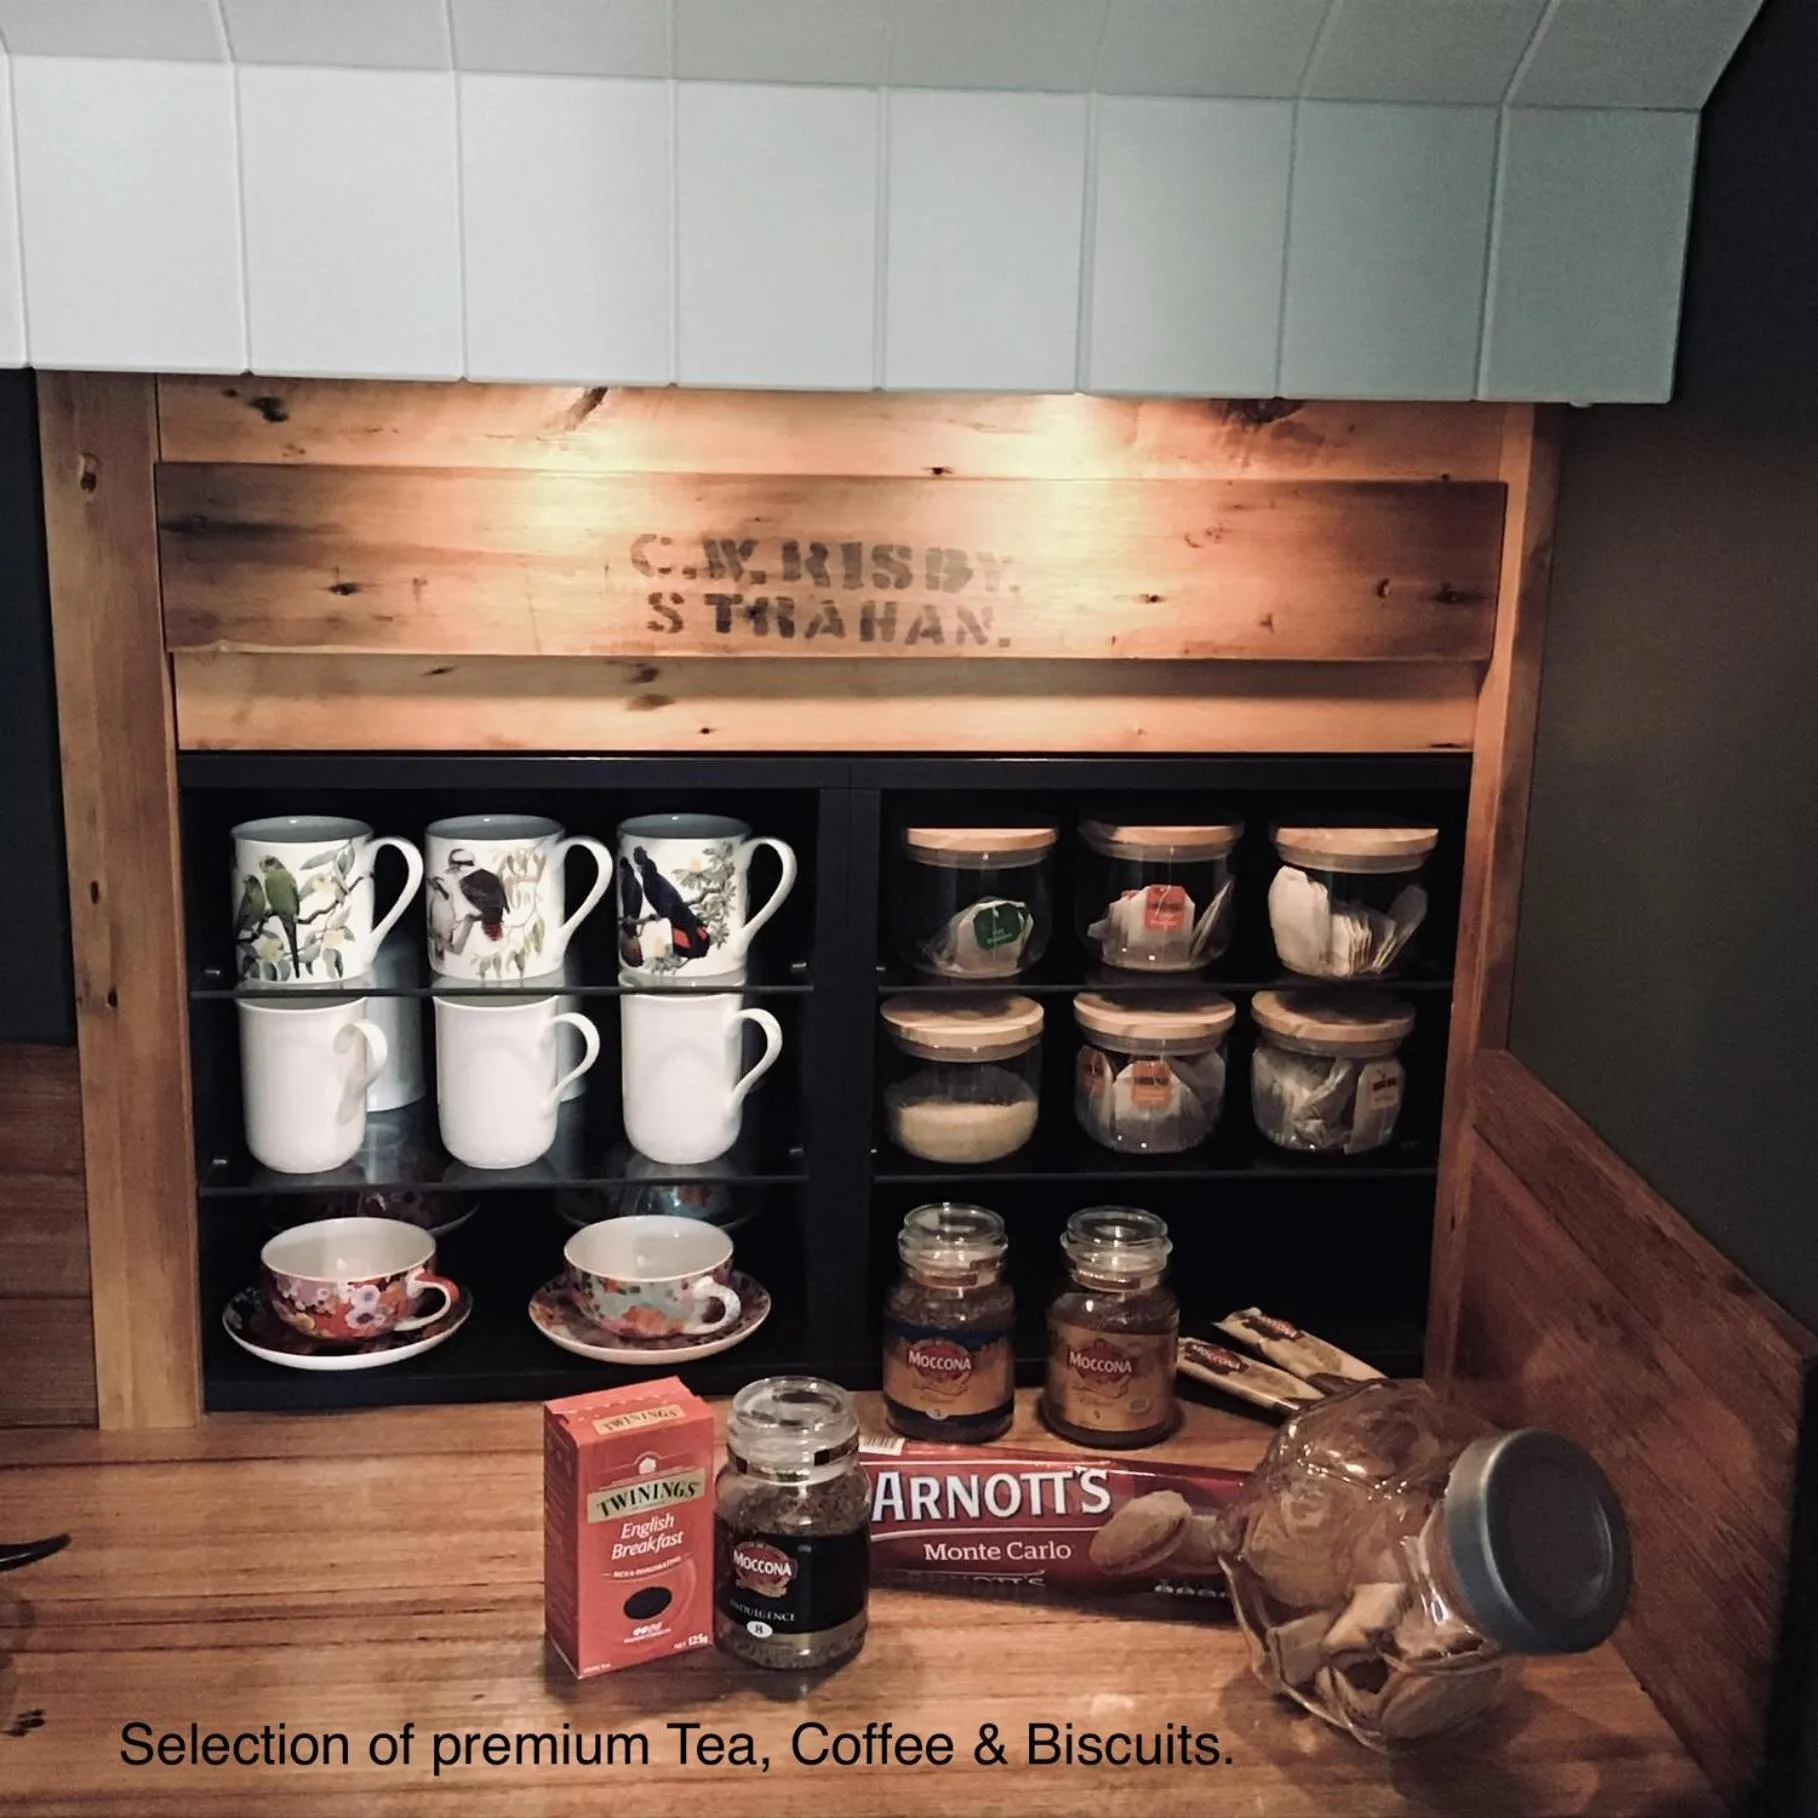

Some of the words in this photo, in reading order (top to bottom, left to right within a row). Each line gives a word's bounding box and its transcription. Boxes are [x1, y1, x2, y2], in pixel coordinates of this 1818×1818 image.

[909, 1350, 972, 1370] MOCCONA
[1069, 1351, 1132, 1373] MOCCONA
[602, 1409, 678, 1431] TWININGS
[596, 1480, 700, 1517] TWININGS
[871, 1466, 1113, 1522] ARNOTT'S
[621, 1513, 675, 1540] English
[611, 1531, 685, 1560] Breakfast
[924, 1543, 1001, 1561] Monte
[1006, 1541, 1072, 1560] Carlo
[733, 1550, 793, 1577] MOCCONA
